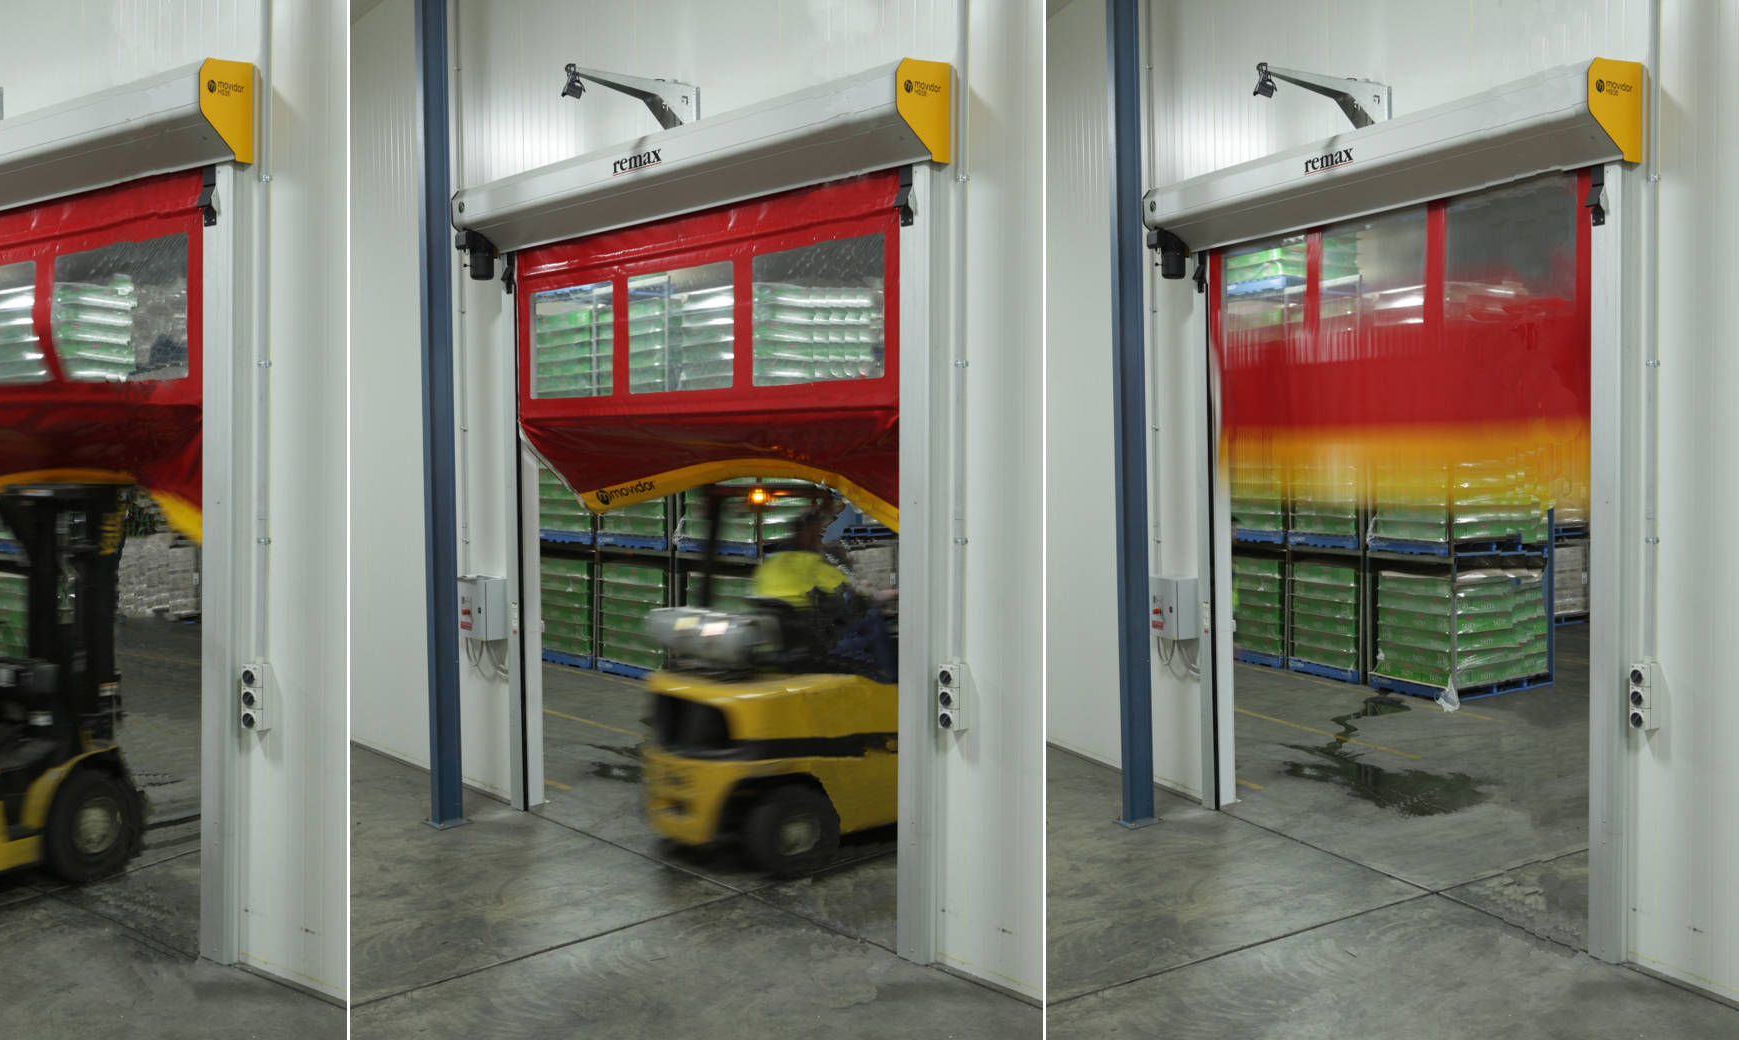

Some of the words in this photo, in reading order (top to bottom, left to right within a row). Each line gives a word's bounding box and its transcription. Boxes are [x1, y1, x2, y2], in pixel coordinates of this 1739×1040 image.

[612, 148, 662, 174] remax
[1304, 147, 1354, 173] remax
[611, 480, 655, 499] movidor
